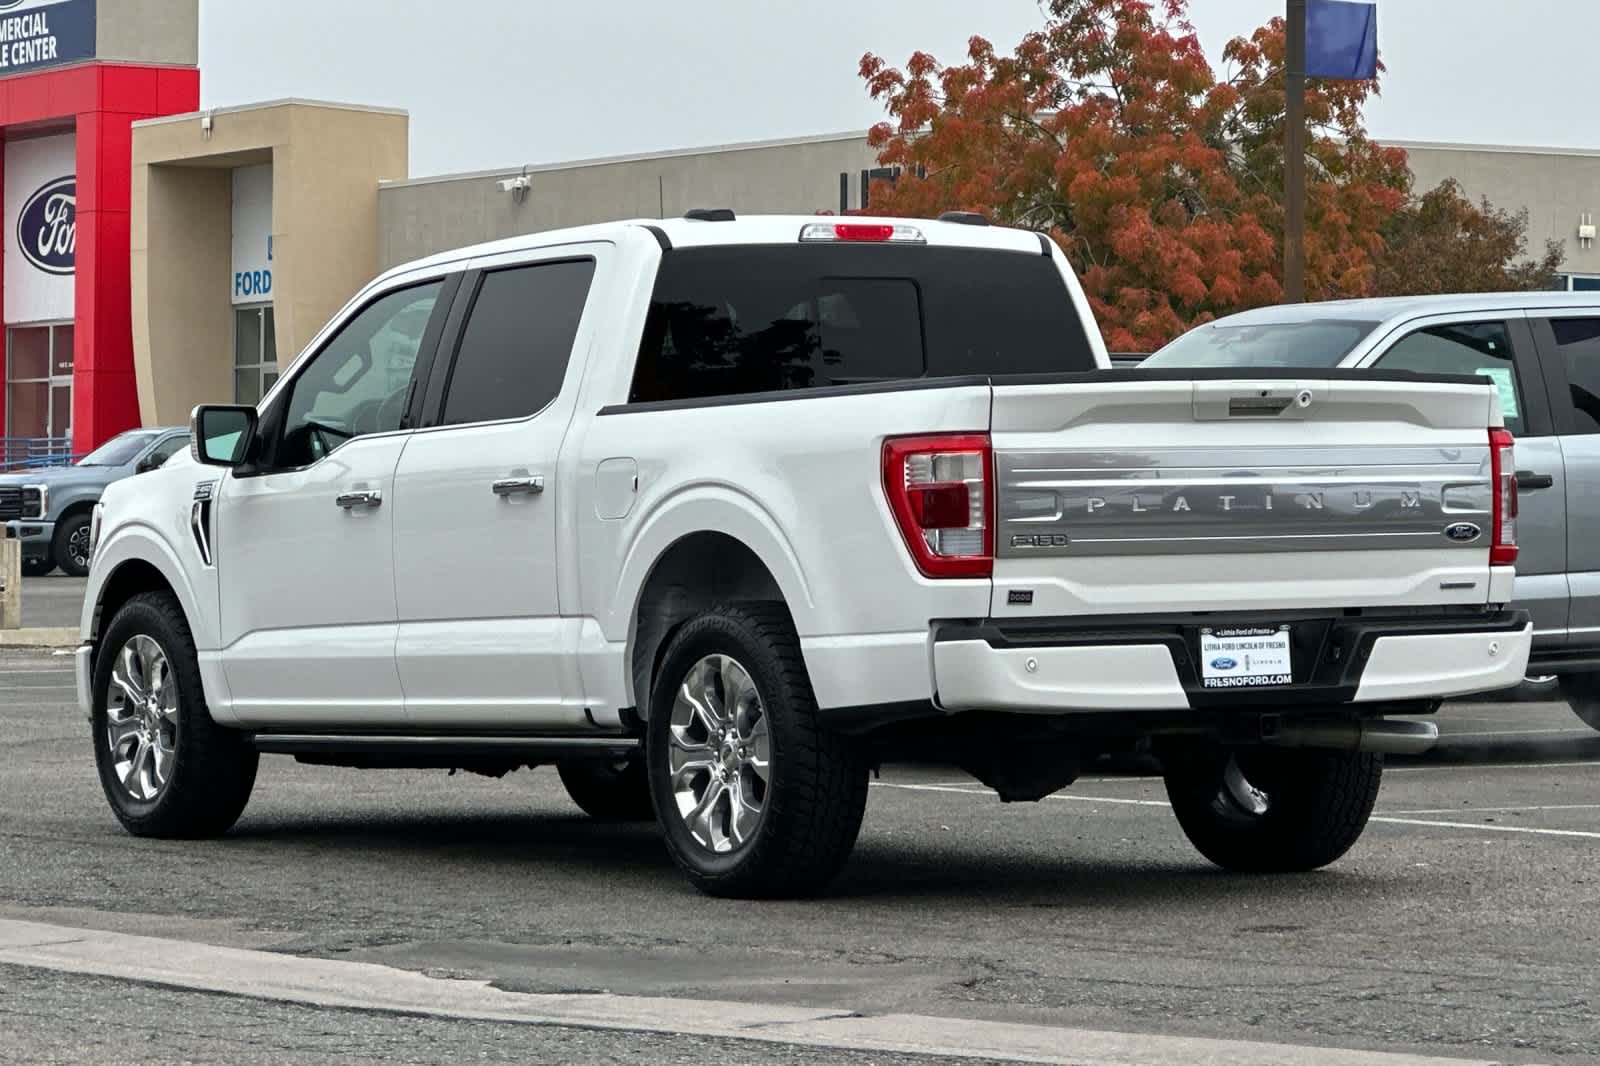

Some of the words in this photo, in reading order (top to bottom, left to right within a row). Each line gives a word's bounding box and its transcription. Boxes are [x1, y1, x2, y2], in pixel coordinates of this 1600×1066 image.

[11, 35, 57, 66] CENTER
[235, 270, 272, 297] FORD
[1087, 491, 1421, 513] PLATINUM
[1204, 675, 1292, 688] FRESNOFORD.COM
